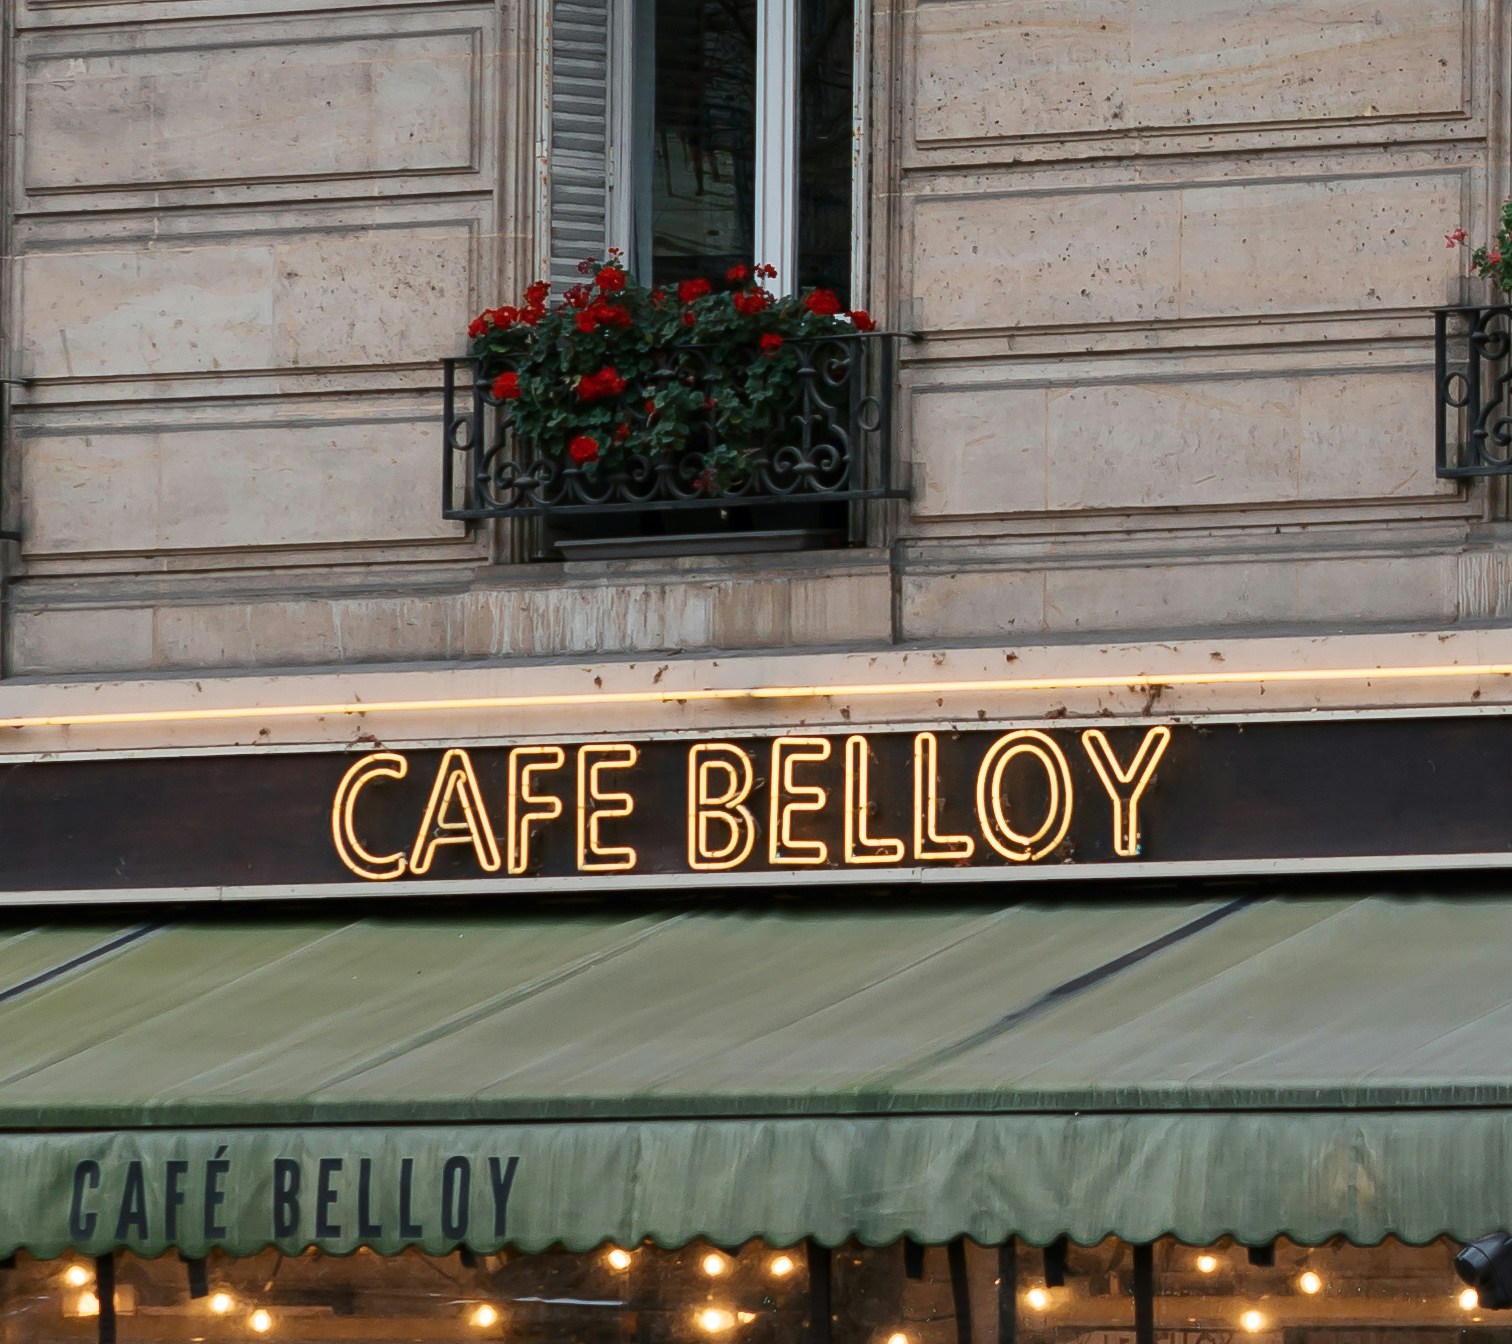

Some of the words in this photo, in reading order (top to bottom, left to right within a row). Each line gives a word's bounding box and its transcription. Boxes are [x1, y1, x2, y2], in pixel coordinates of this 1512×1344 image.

[332, 742, 639, 880] CAFE
[687, 725, 1172, 870] BELLOY
[68, 1143, 228, 1242] CAFÉ
[273, 1154, 521, 1239] BELLOY
